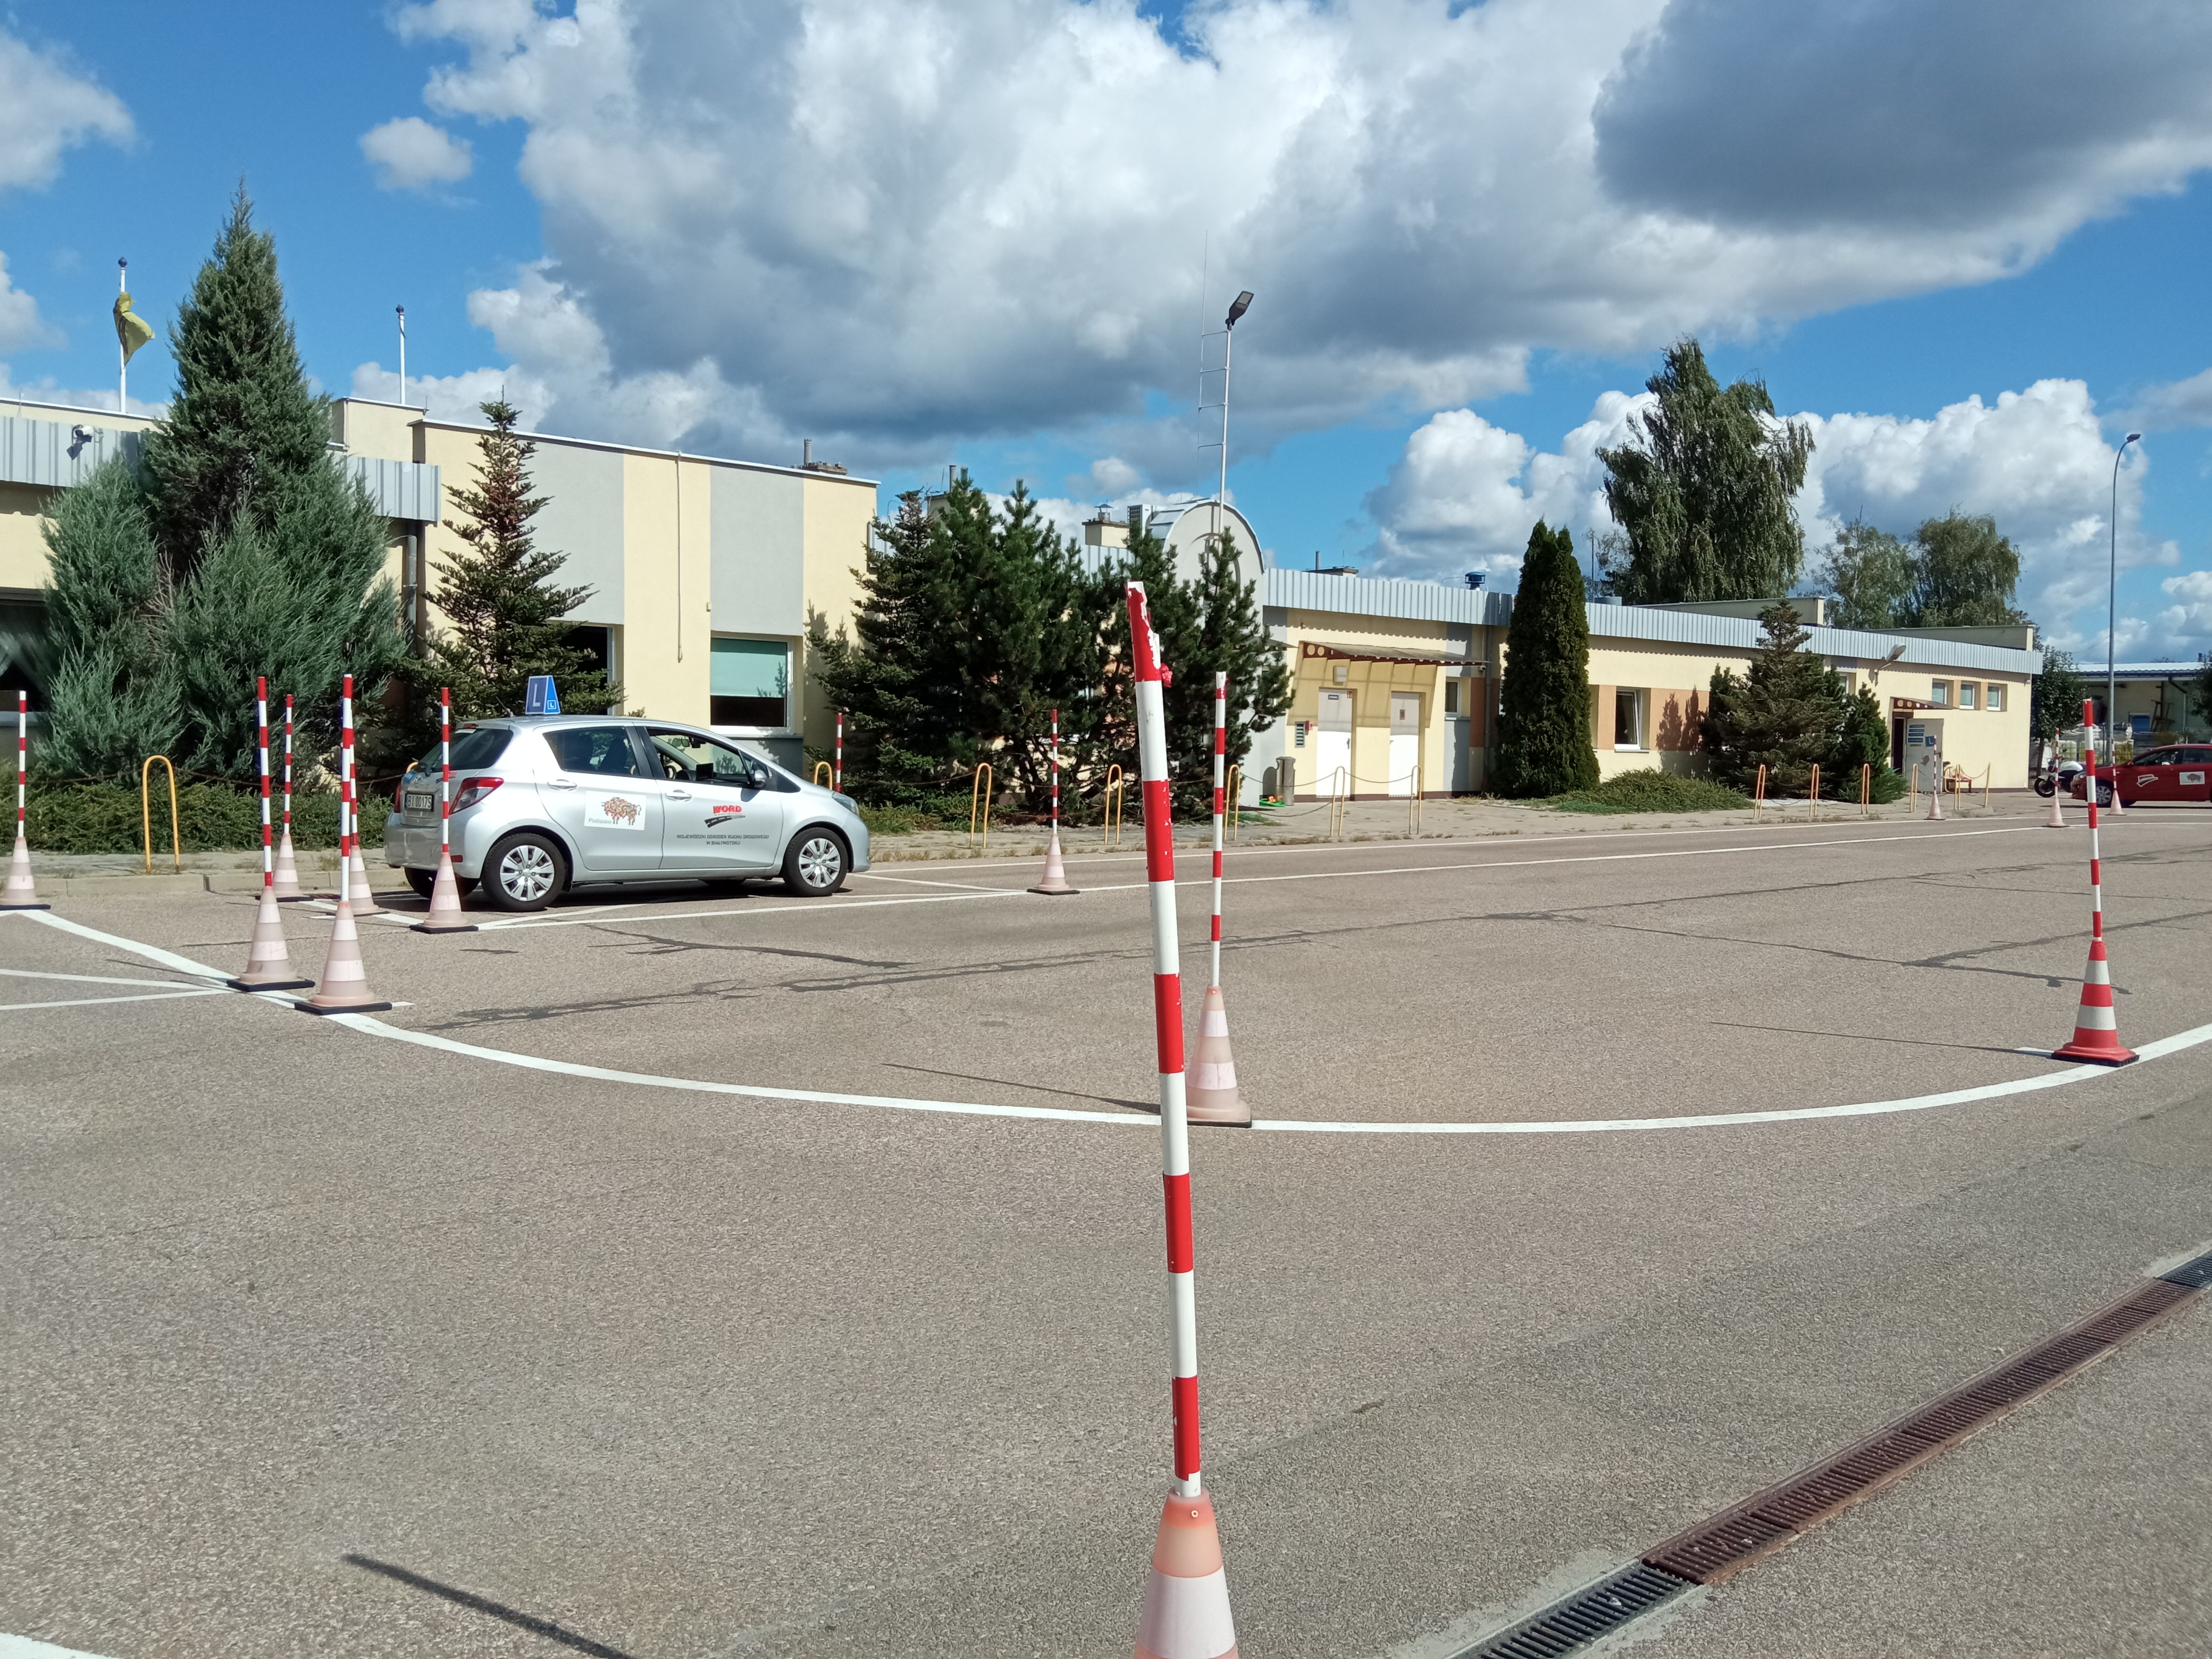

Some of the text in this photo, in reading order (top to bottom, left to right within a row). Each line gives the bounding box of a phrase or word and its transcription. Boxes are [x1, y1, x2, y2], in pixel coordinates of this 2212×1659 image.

[533, 683, 540, 707] L
[408, 795, 414, 807] BI
[713, 806, 742, 814] WORD
